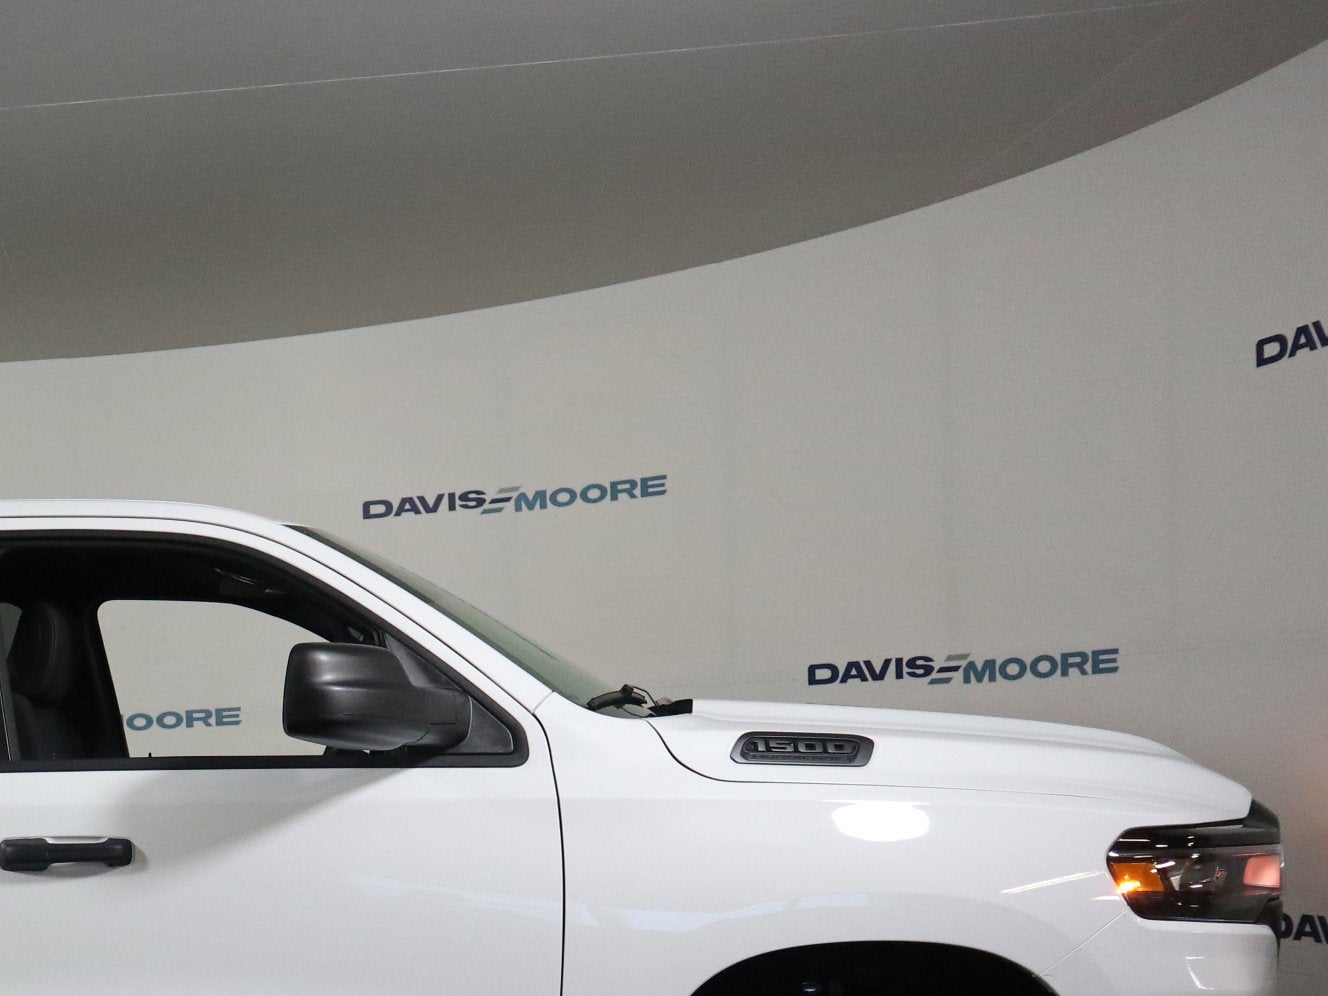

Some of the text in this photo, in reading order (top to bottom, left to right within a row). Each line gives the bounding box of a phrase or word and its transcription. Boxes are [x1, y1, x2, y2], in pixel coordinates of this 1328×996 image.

[362, 474, 667, 520] DAVIS MOORE
[807, 648, 1119, 686] DAVIS MOORE
[123, 706, 242, 731] OORE
[752, 739, 854, 753] 1500
